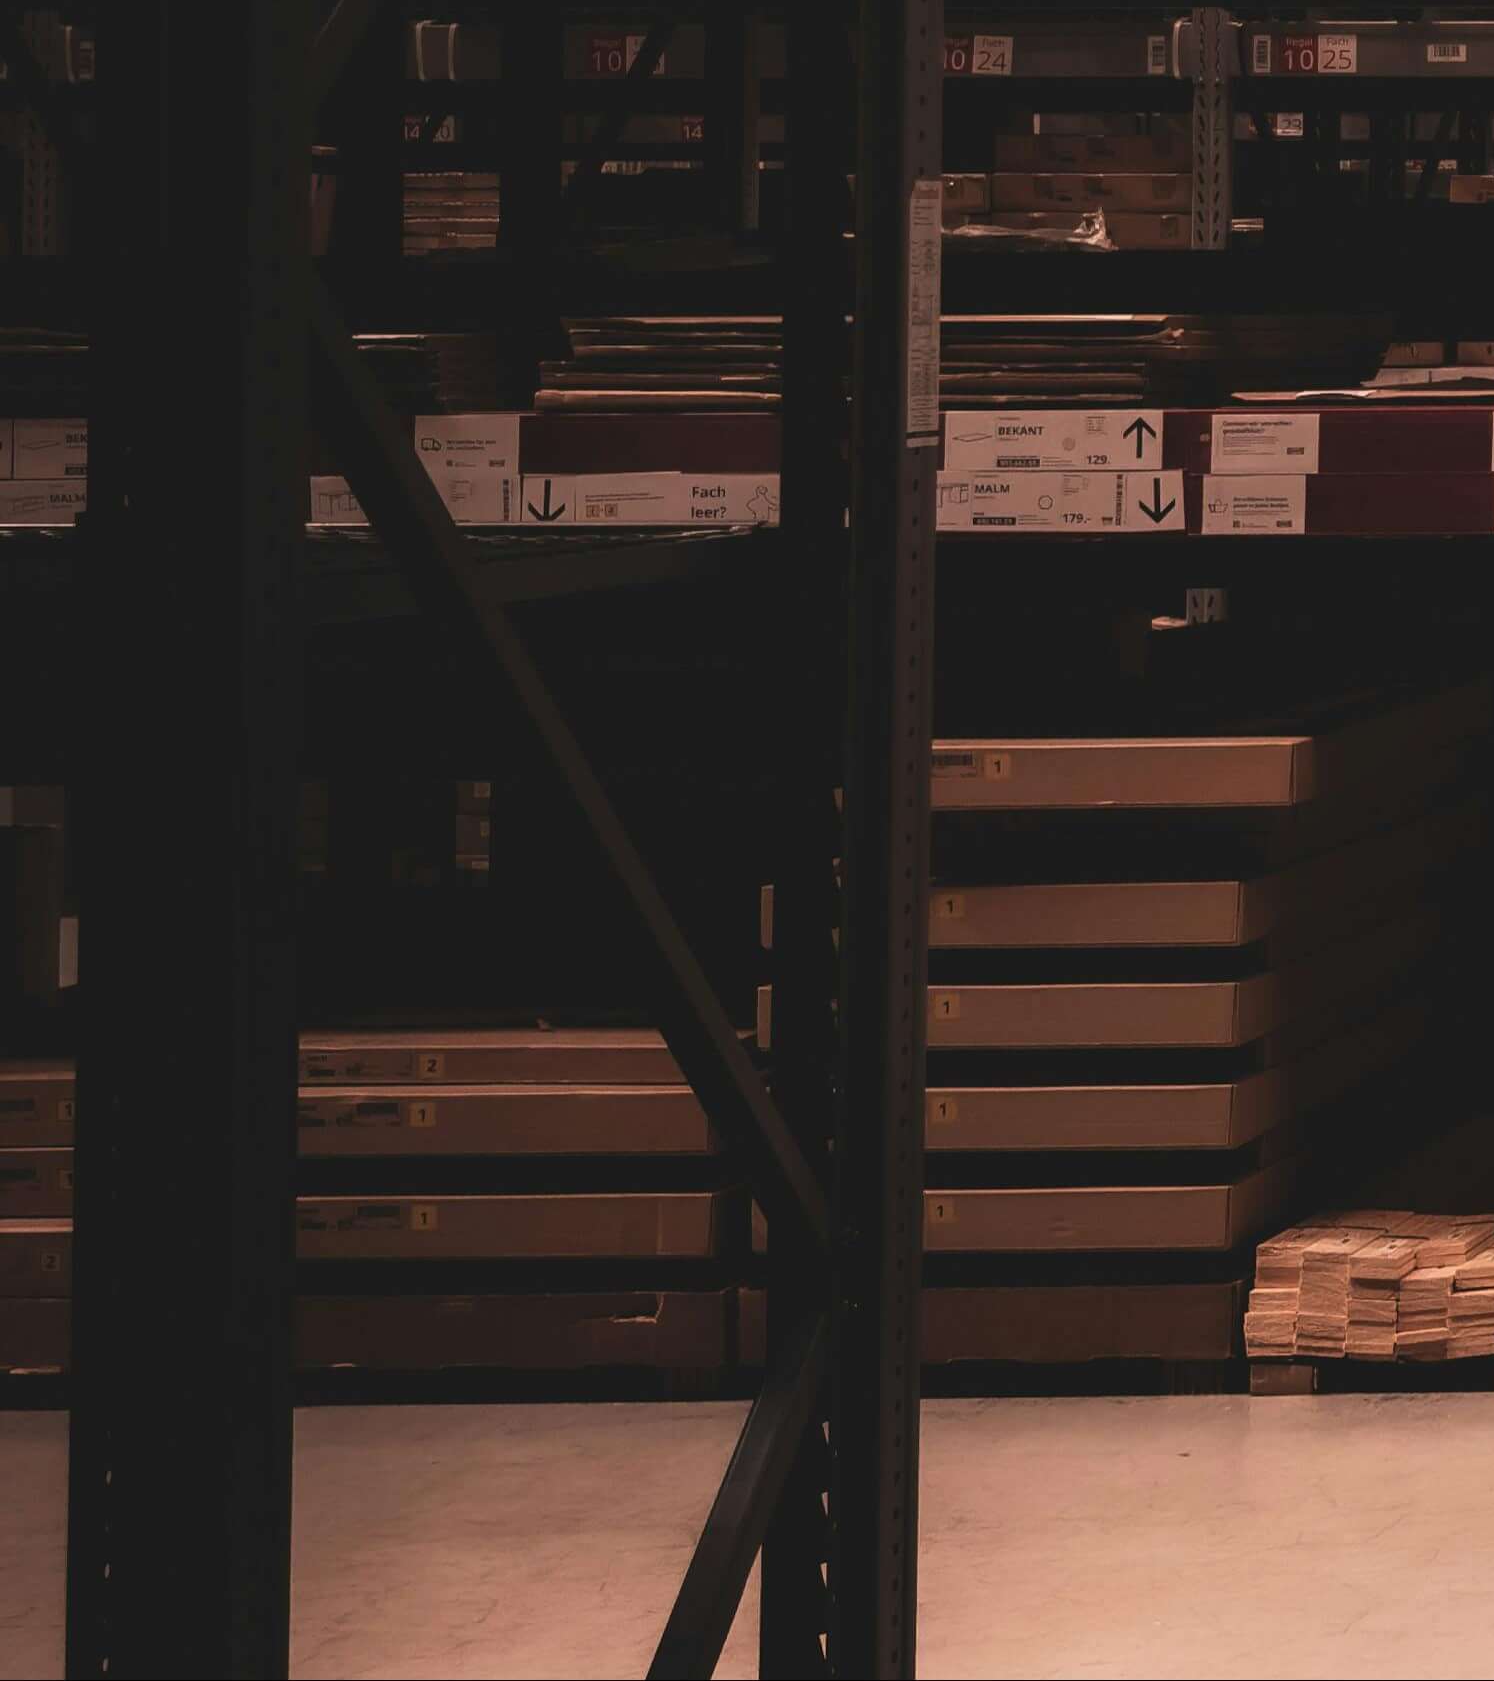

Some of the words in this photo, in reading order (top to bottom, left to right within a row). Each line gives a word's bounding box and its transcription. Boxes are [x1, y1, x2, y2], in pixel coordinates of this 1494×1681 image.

[1286, 38, 1313, 49] Regal
[1327, 37, 1349, 47] Fach
[592, 51, 622, 72] 10
[977, 50, 1006, 72] 24
[1285, 50, 1314, 71] 10
[1323, 50, 1353, 71] 25
[683, 124, 703, 139] 14
[998, 426, 1044, 436] BEKANT
[692, 486, 727, 499] Fach
[974, 484, 1011, 494] MALM
[691, 506, 728, 520] leer?
[1063, 513, 1092, 523] 179.-
[994, 760, 1001, 773] 1
[946, 900, 953, 914] 1
[944, 1001, 949, 1015] 1
[427, 1059, 437, 1073] 2
[419, 1109, 425, 1123] 1
[940, 1103, 946, 1117] 1
[421, 1212, 427, 1224] 1
[938, 1205, 944, 1218] 1
